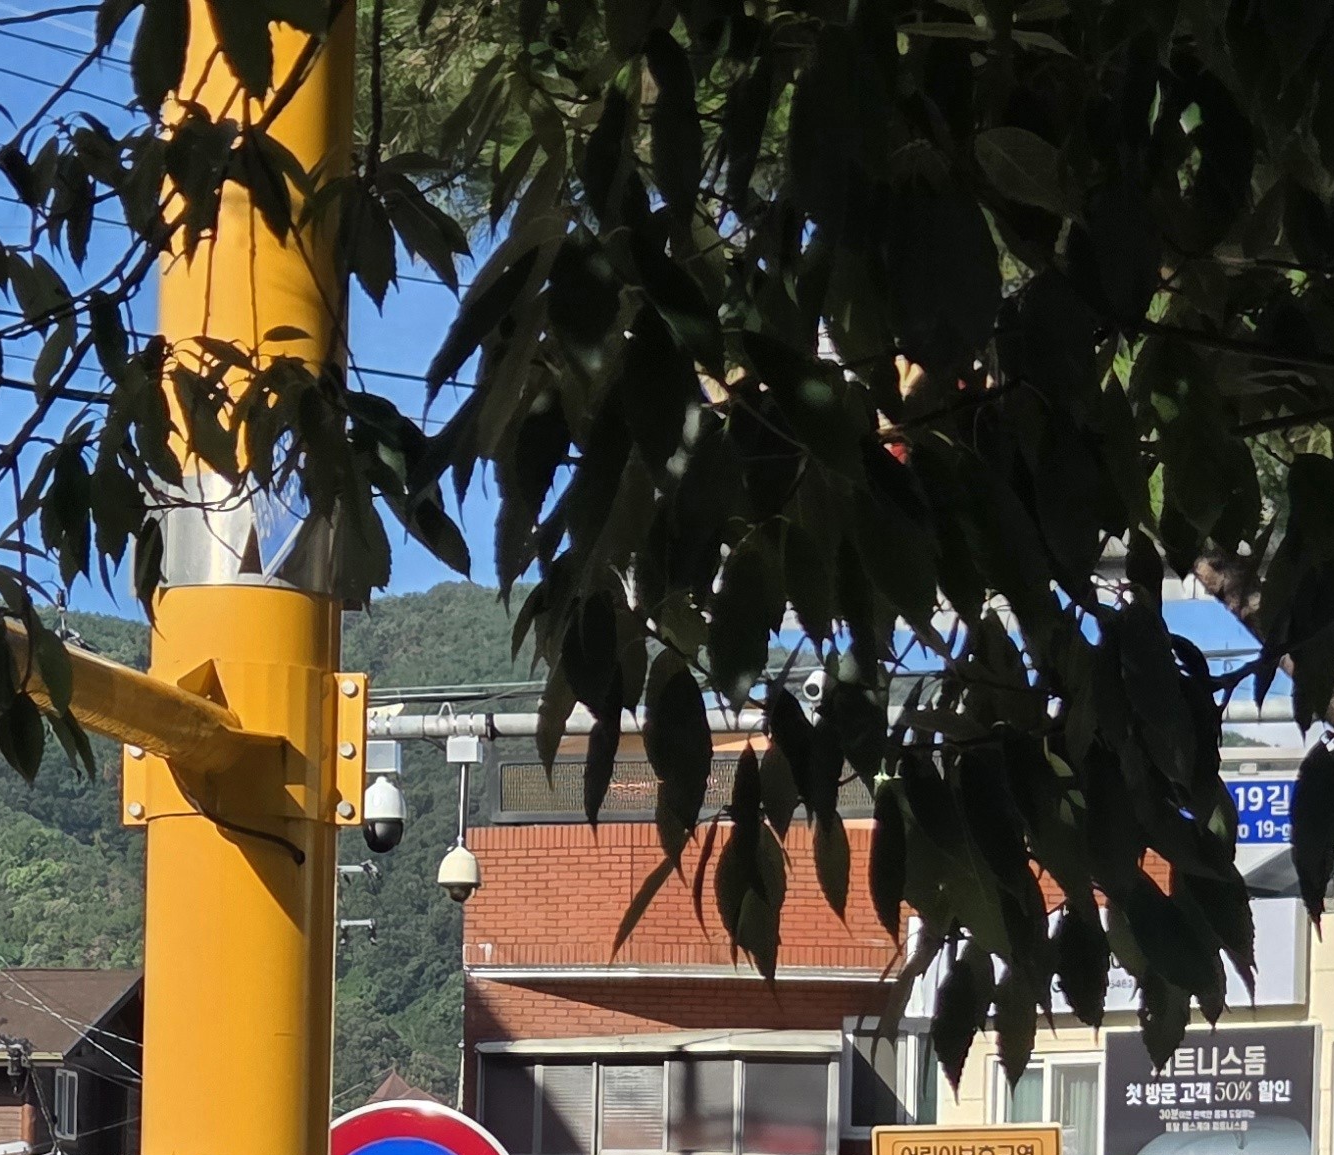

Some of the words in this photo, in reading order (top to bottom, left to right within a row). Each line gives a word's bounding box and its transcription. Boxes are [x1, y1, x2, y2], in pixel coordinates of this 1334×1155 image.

[1255, 820, 1291, 842] 19-g
[1126, 1083, 1142, 1105] 첫
[1145, 1083, 1177, 1105] 방문
[1180, 1082, 1212, 1104] 고객
[1214, 1080, 1253, 1102] 50%
[1258, 1079, 1292, 1103] 할인
